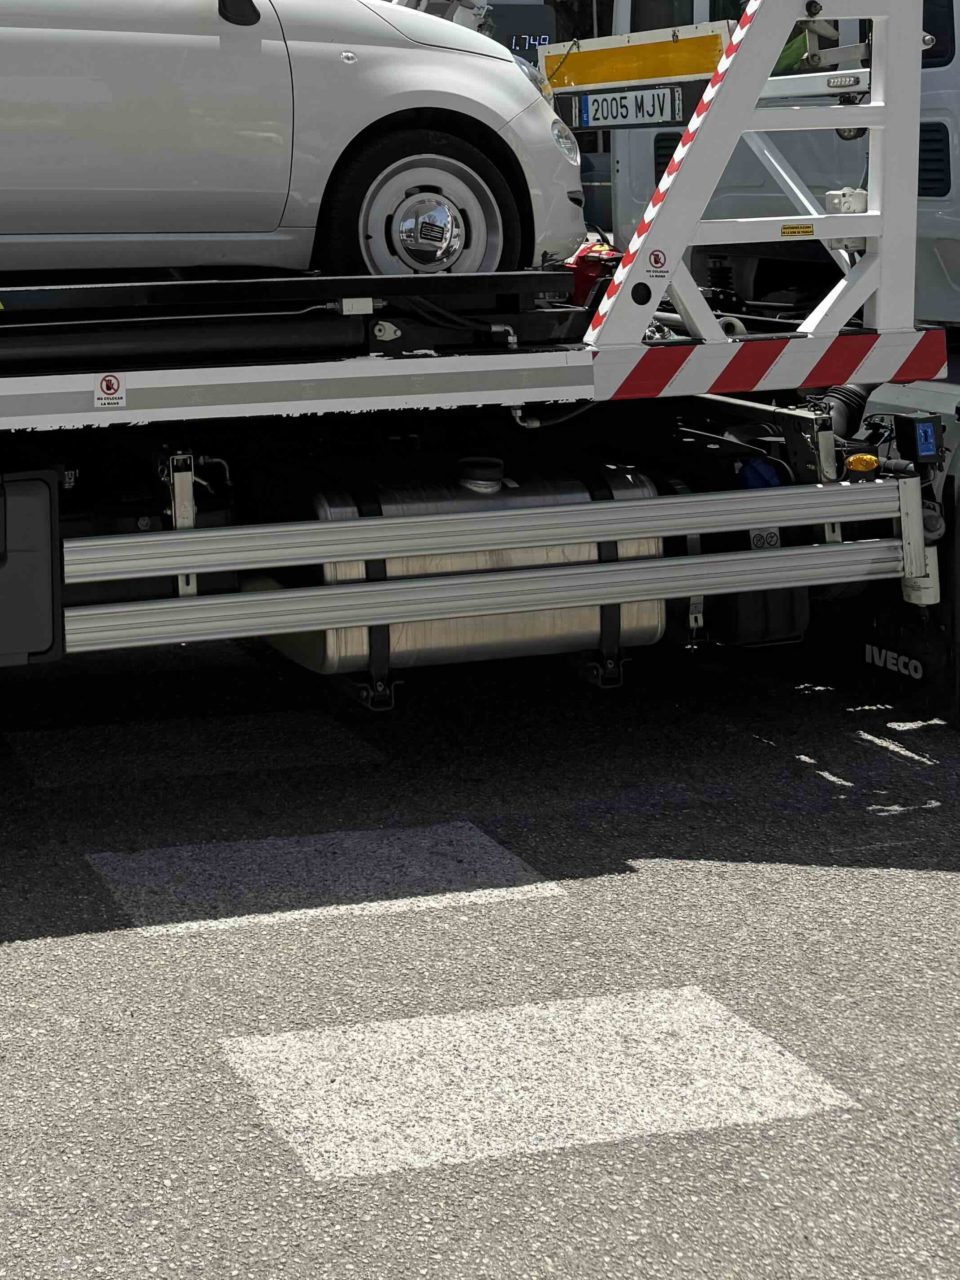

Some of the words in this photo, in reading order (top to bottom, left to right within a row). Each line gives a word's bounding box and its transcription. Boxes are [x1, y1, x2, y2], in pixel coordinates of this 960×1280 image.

[512, 35, 549, 50] 1.749
[592, 96, 629, 121] 2005
[635, 93, 666, 118] MJV
[865, 644, 923, 680] IVECO
